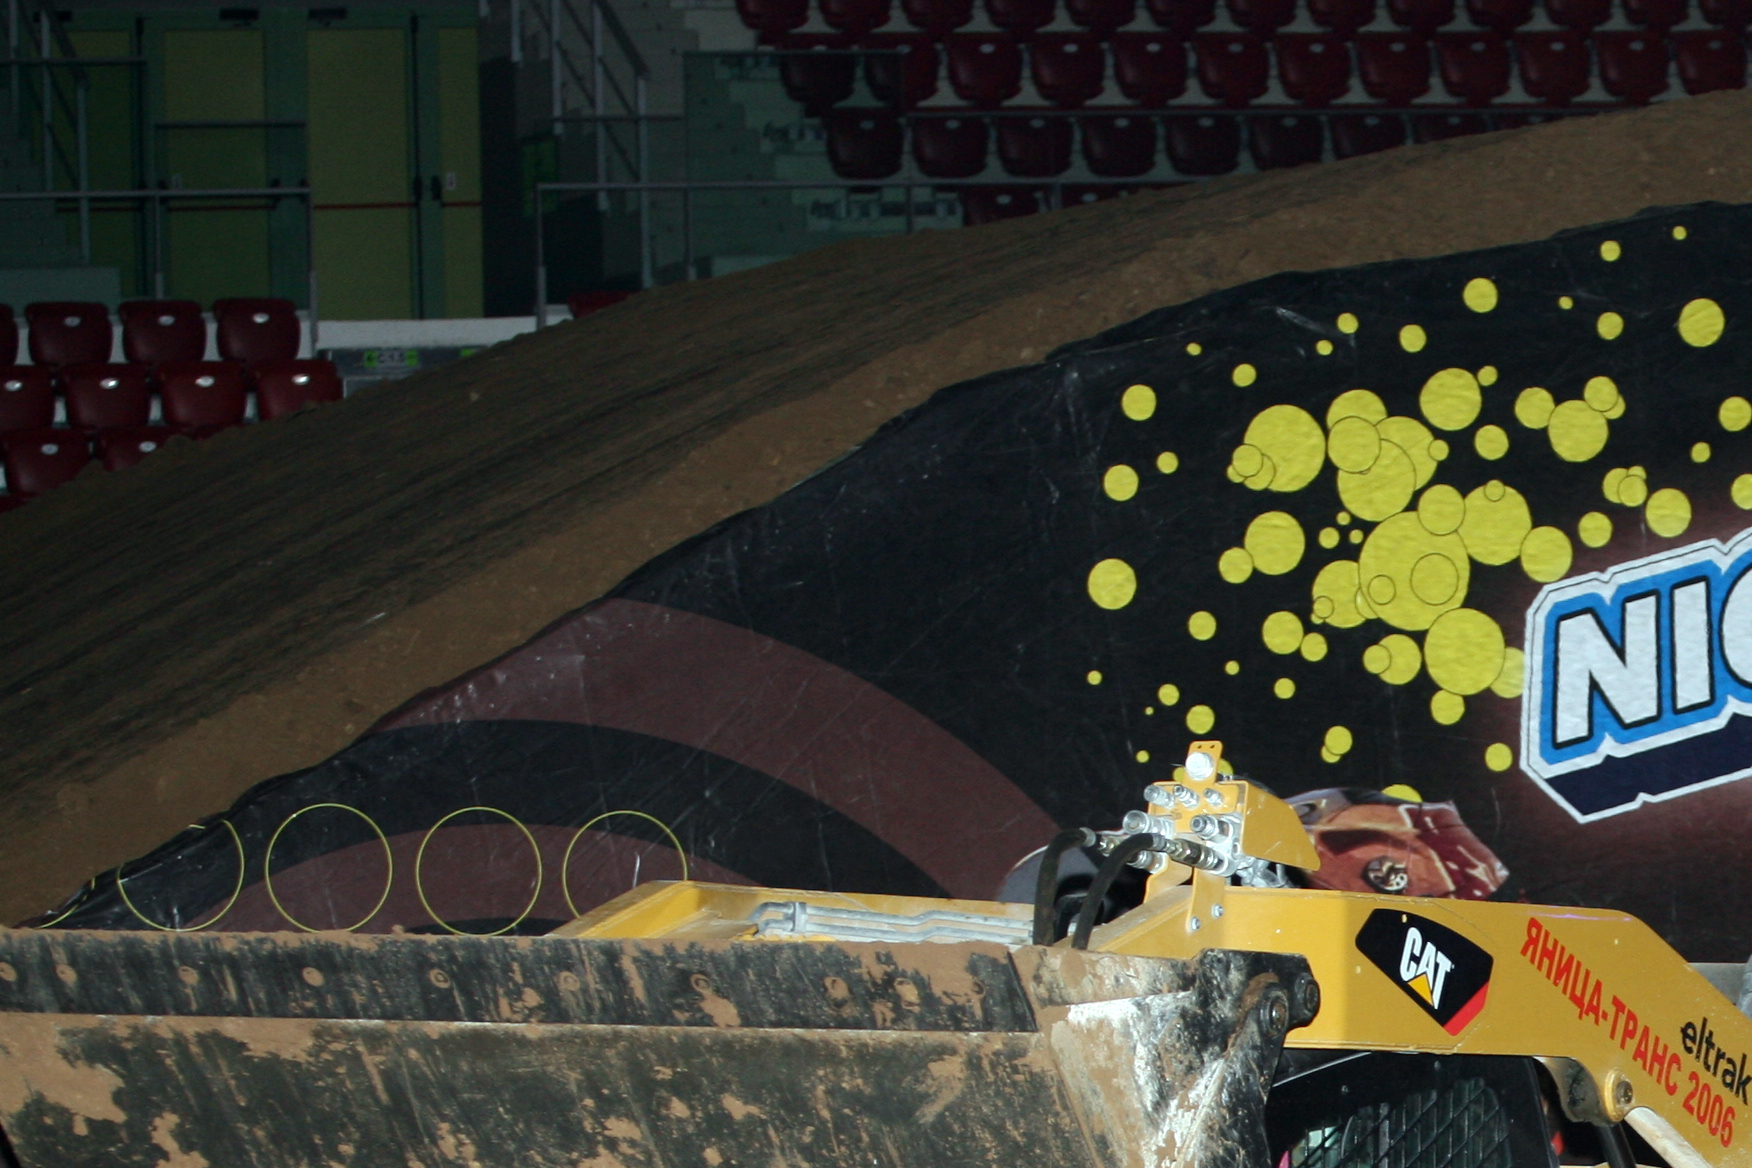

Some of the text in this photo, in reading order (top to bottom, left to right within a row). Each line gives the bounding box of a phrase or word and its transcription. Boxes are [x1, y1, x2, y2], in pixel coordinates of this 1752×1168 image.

[1399, 926, 1453, 1010] CAT
[1520, 916, 1737, 1149] ЯНИЦА-ТРАНС 2006
